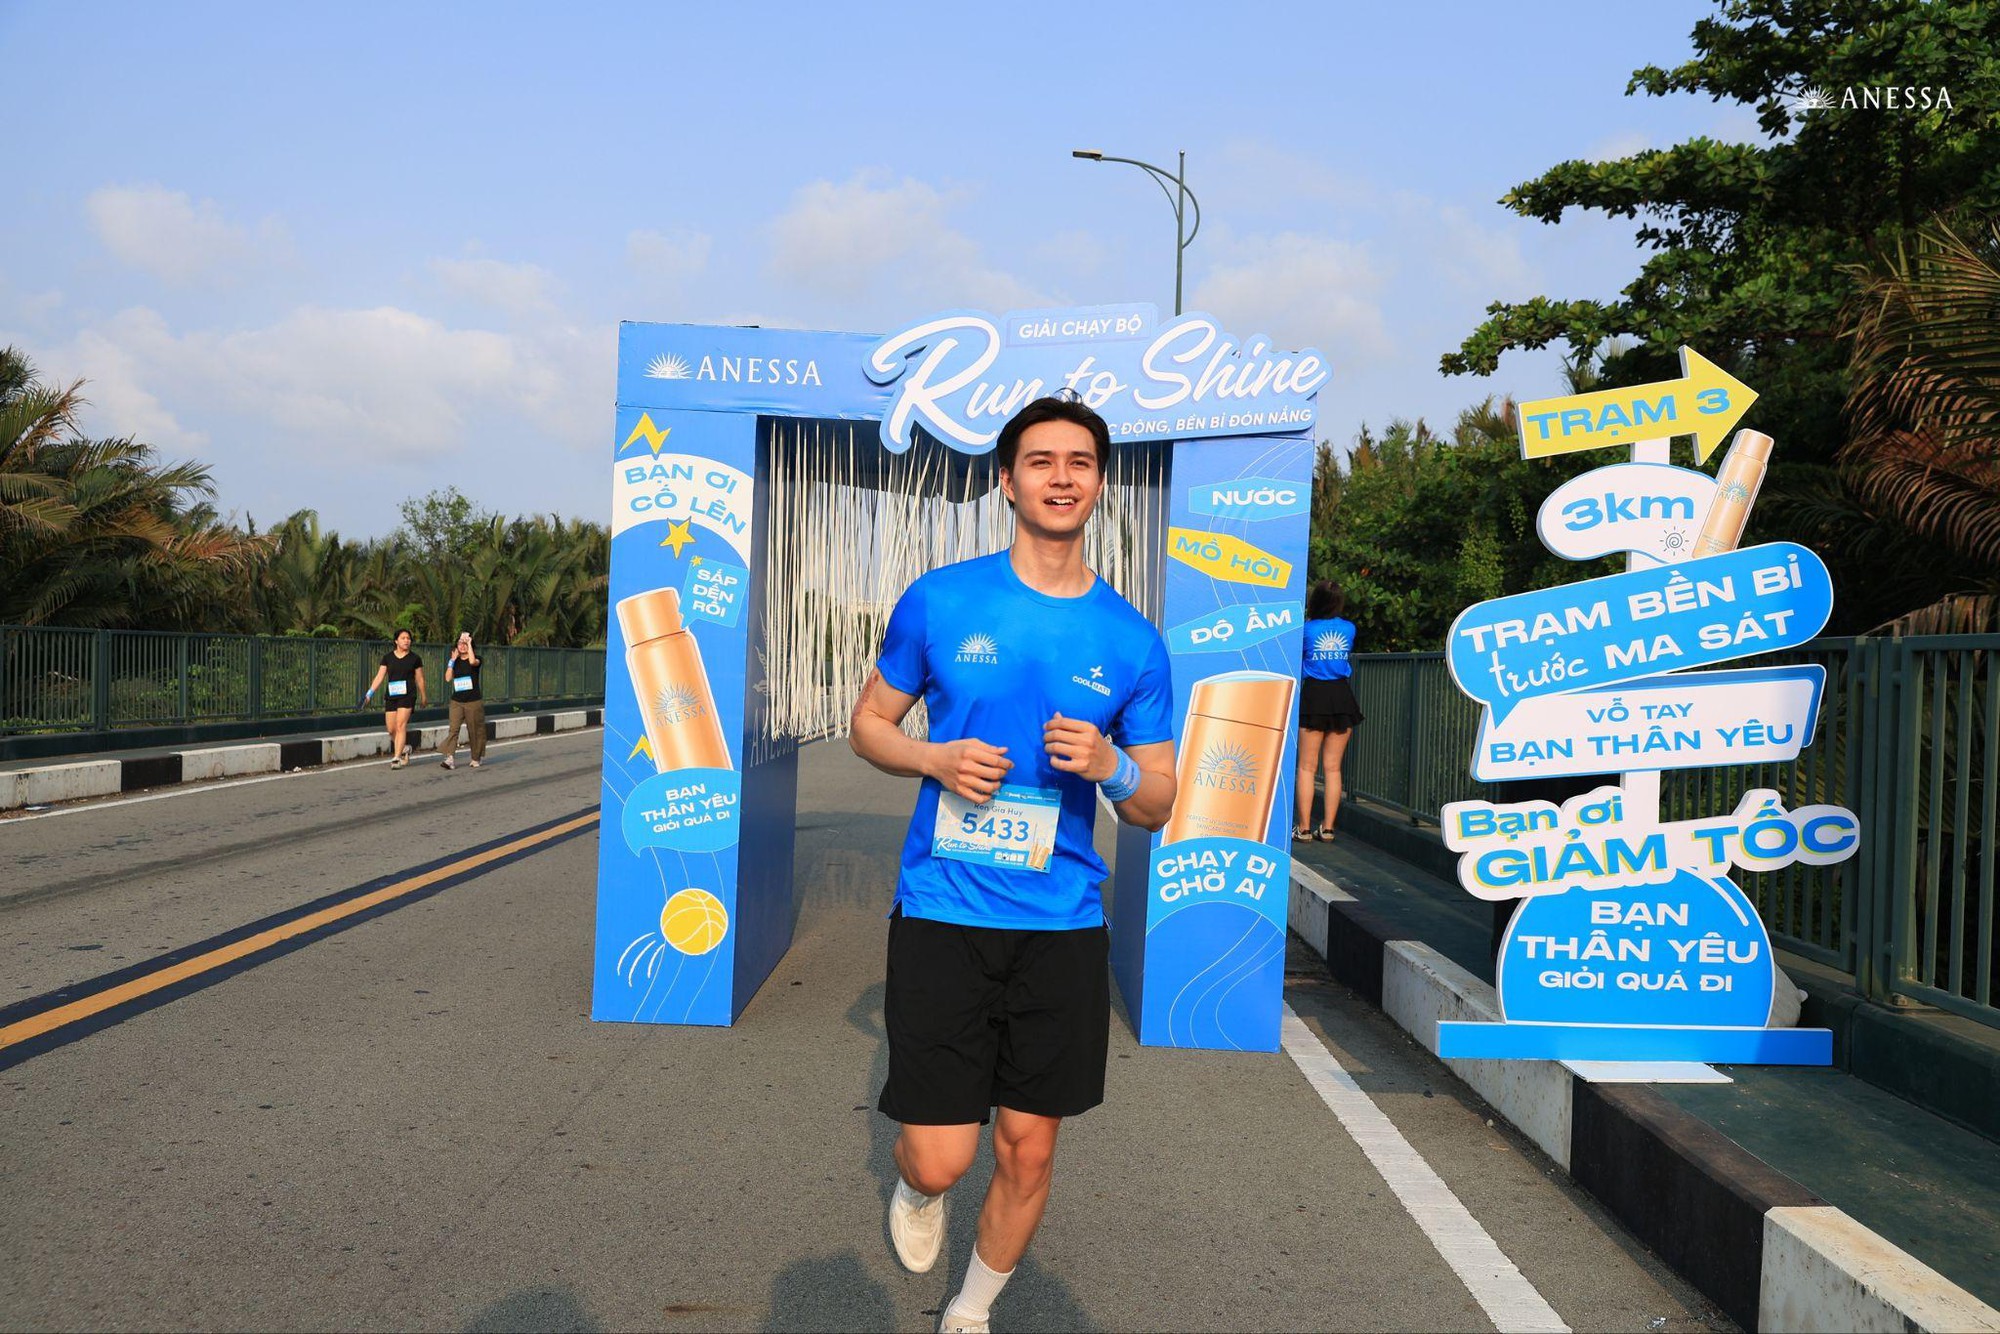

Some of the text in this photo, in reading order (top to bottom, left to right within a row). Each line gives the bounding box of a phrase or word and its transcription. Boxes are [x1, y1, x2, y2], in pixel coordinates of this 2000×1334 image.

[1018, 313, 1143, 338] GIẢI CHẠY BỘ
[696, 355, 823, 387] ANESSA
[871, 316, 1327, 446] Run to Shine
[1120, 419, 1171, 437] ĐỘNG,
[1175, 413, 1206, 431] BỀN
[1229, 411, 1264, 427] ĐÓN
[1267, 405, 1312, 425] NẮNG
[1526, 388, 1731, 439] TRẠM 3
[624, 463, 738, 494] BẠN ƠI
[630, 483, 747, 535] CỐ LÊN
[1212, 486, 1297, 506] NƯỚC
[1561, 492, 1695, 532] 3km
[1175, 536, 1281, 581] MỒ HÔI
[696, 568, 738, 587] SẮP
[1460, 552, 1804, 654] TRẠM BỀN BỈ
[1190, 606, 1292, 645] ĐỘ ẨM
[954, 653, 998, 665] ANESSA
[1312, 651, 1350, 661] ANESSA
[1489, 610, 1796, 698] trước MA SÁT
[654, 704, 708, 729] ANESSA
[1586, 697, 1694, 723] VỖ TAY
[1490, 719, 1794, 766] BẠN THÂN YÊU
[665, 783, 706, 802] BẠN
[1193, 770, 1258, 796] ANESSA
[640, 792, 737, 823] THÂN YÊU
[652, 819, 681, 834] GIỎI
[683, 812, 713, 827] QUÁ
[1457, 795, 1624, 840] Bạn ơi
[961, 811, 1030, 842] 5433
[1474, 798, 1856, 888] GIẢM TỐC
[1156, 850, 1277, 879] CHẠY ĐI
[1159, 869, 1267, 903] CHỜ AI
[1591, 901, 1689, 931] BẠN
[1517, 931, 1759, 963] THÂN YÊU
[1538, 966, 1733, 992] GIỎI QUÁ ĐI
